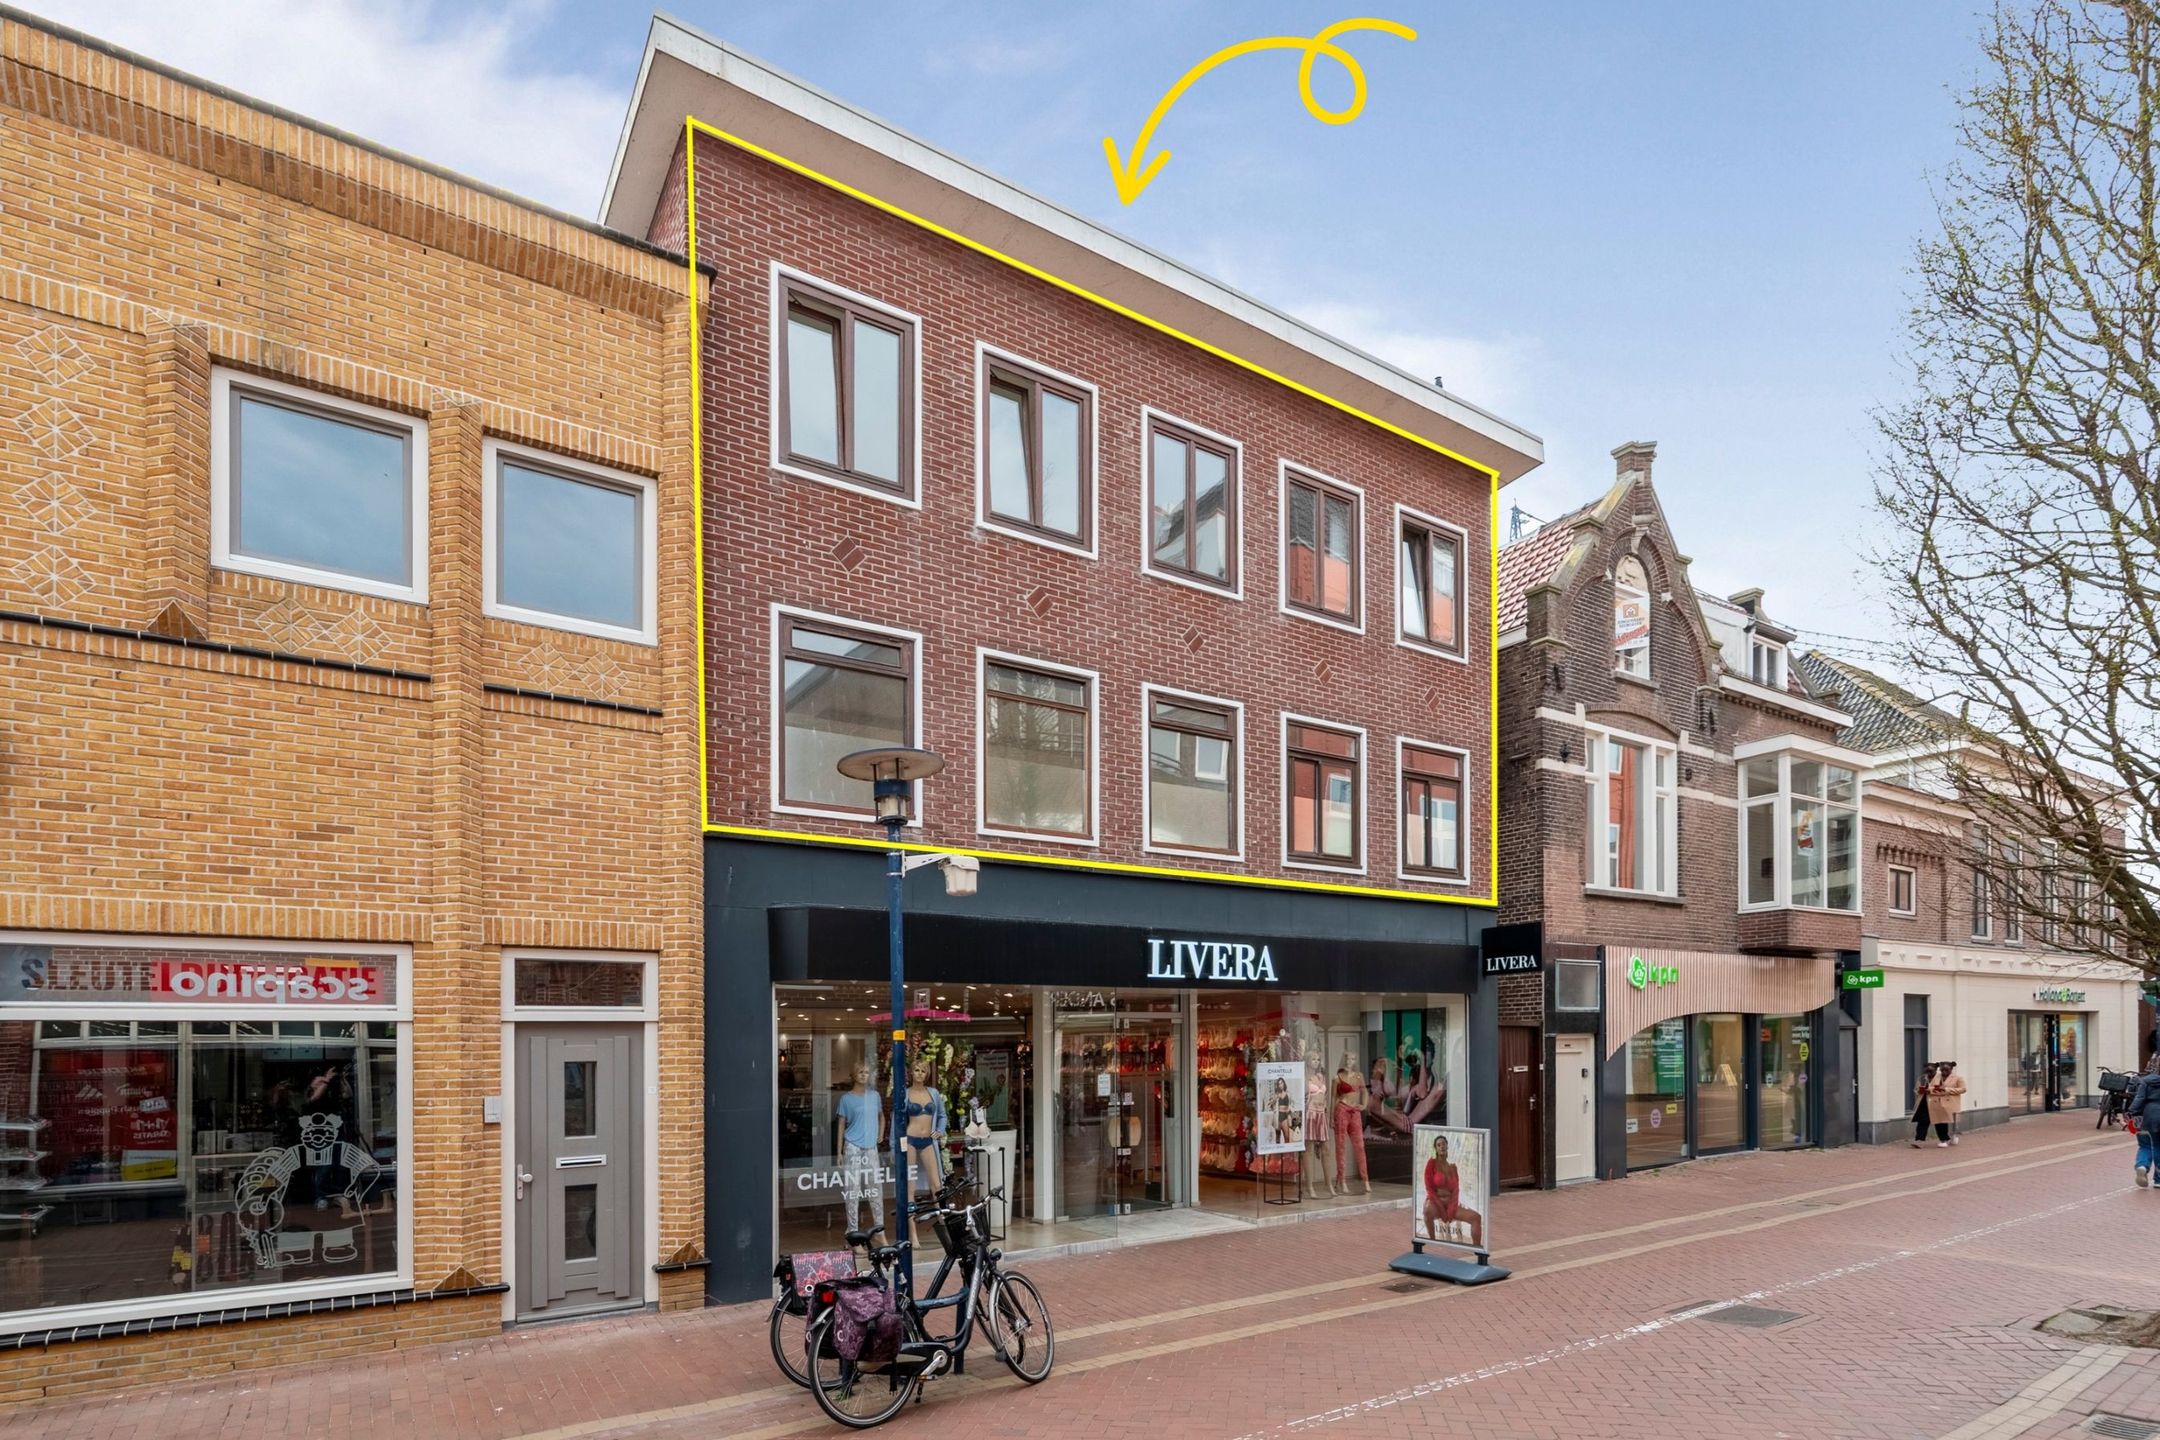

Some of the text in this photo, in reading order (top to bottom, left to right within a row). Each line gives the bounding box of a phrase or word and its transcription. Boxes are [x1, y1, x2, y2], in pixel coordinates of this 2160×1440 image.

[1147, 939, 1279, 982] LIVERA
[1486, 954, 1538, 972] LIVERA
[1648, 961, 1680, 988] kpn
[1859, 975, 1879, 984] kpn
[850, 1155, 869, 1166] 150
[797, 1165, 919, 1191] CHANTELE
[841, 1188, 879, 1200] YEARS
